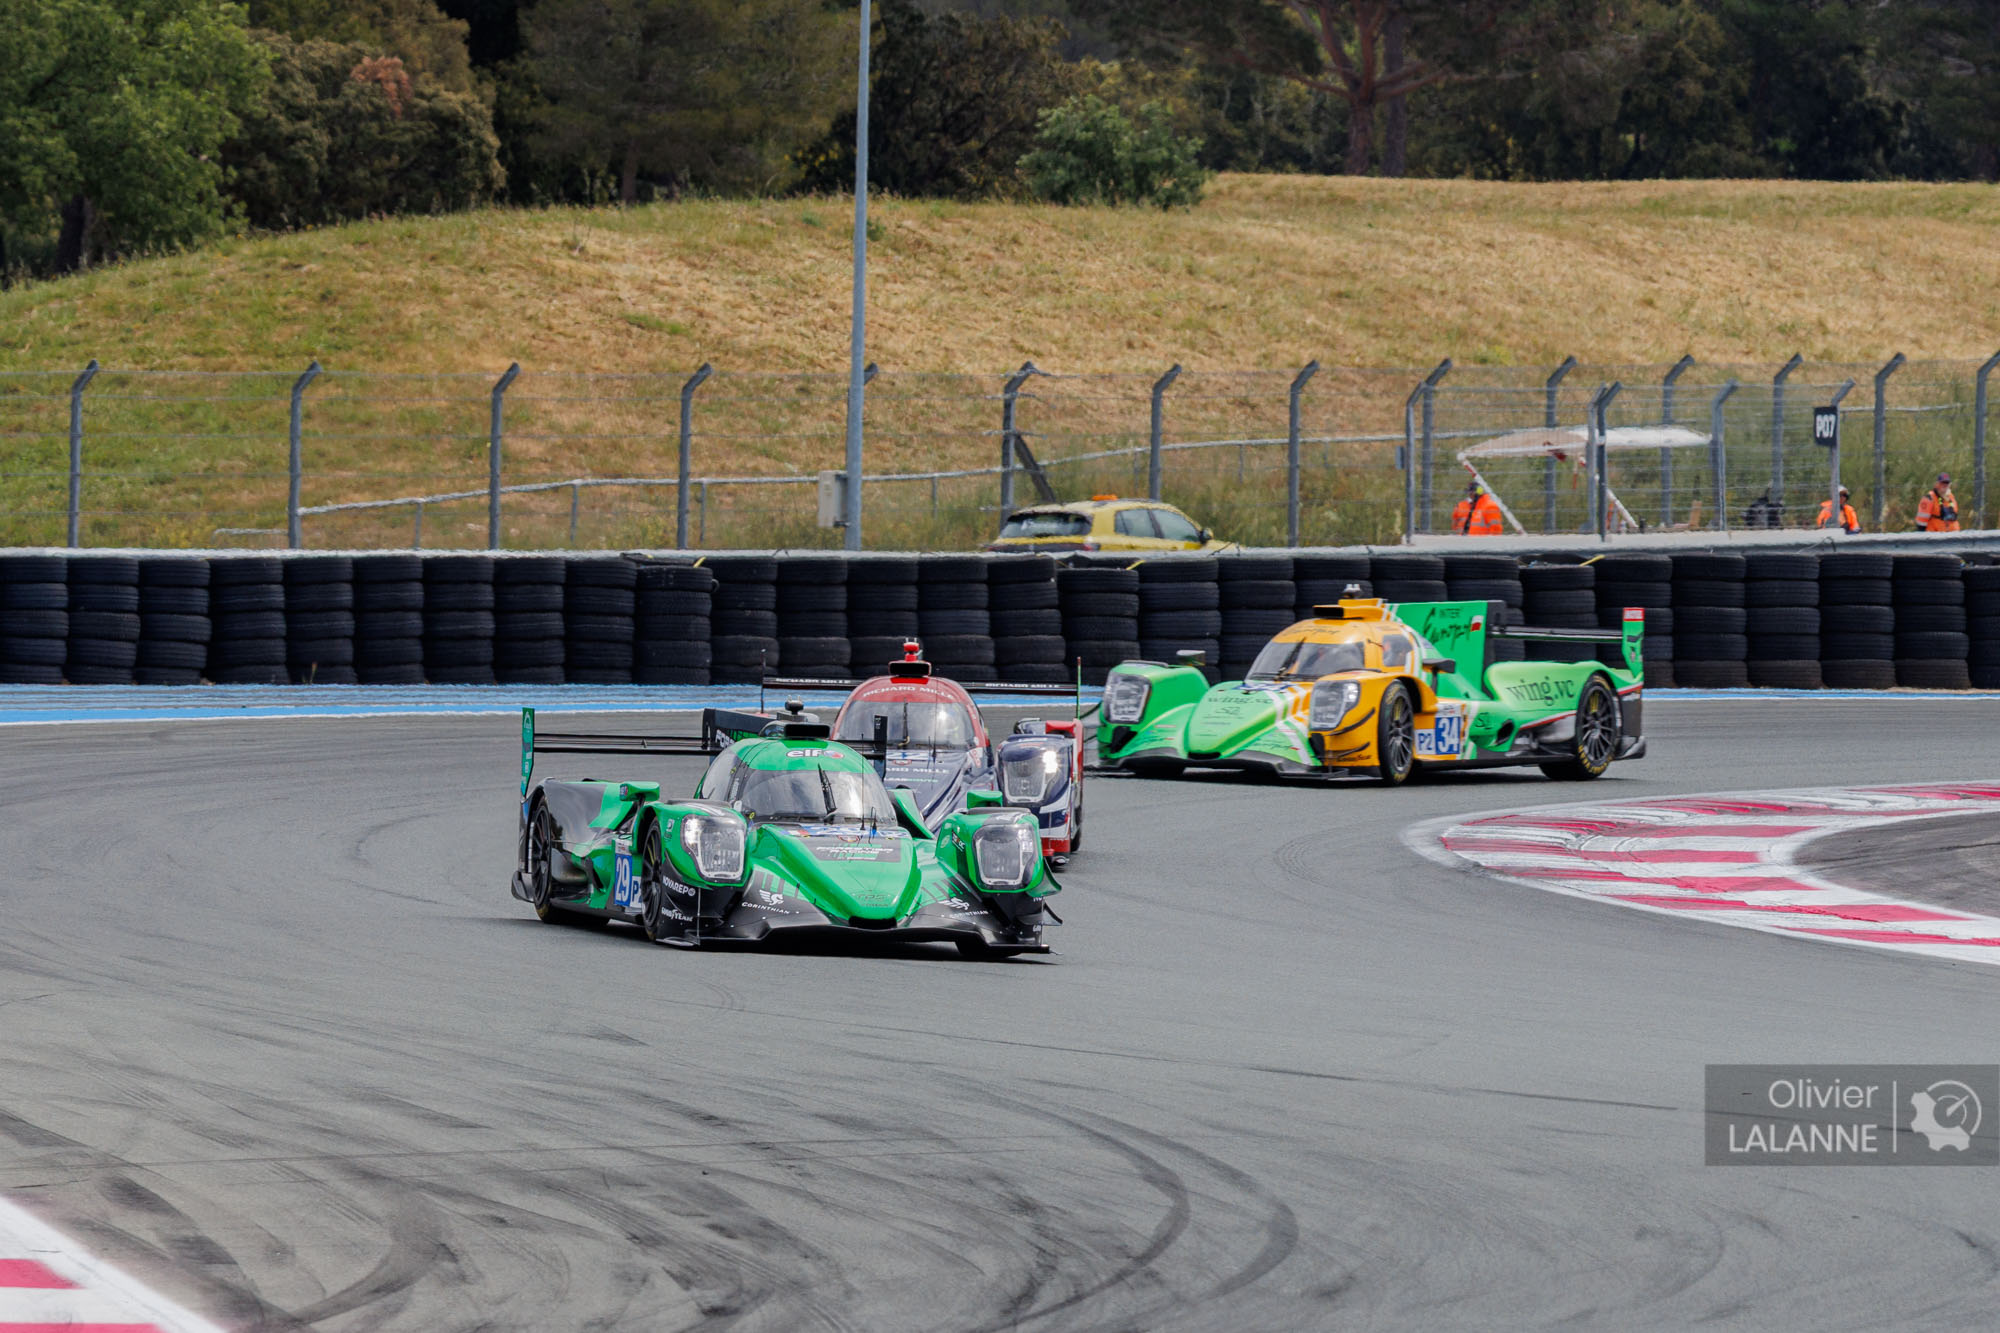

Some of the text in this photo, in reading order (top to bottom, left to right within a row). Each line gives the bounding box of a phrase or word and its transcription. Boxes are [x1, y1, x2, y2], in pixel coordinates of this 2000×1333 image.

[1816, 414, 1837, 438] P07
[862, 686, 956, 700] RICHARD MILLE
[1506, 675, 1575, 706] wing.vc
[1417, 732, 1434, 751] P2
[1437, 717, 1460, 754] 34
[786, 749, 824, 758] elf
[615, 857, 631, 903] 29
[741, 901, 790, 915] CORINTHIAN
